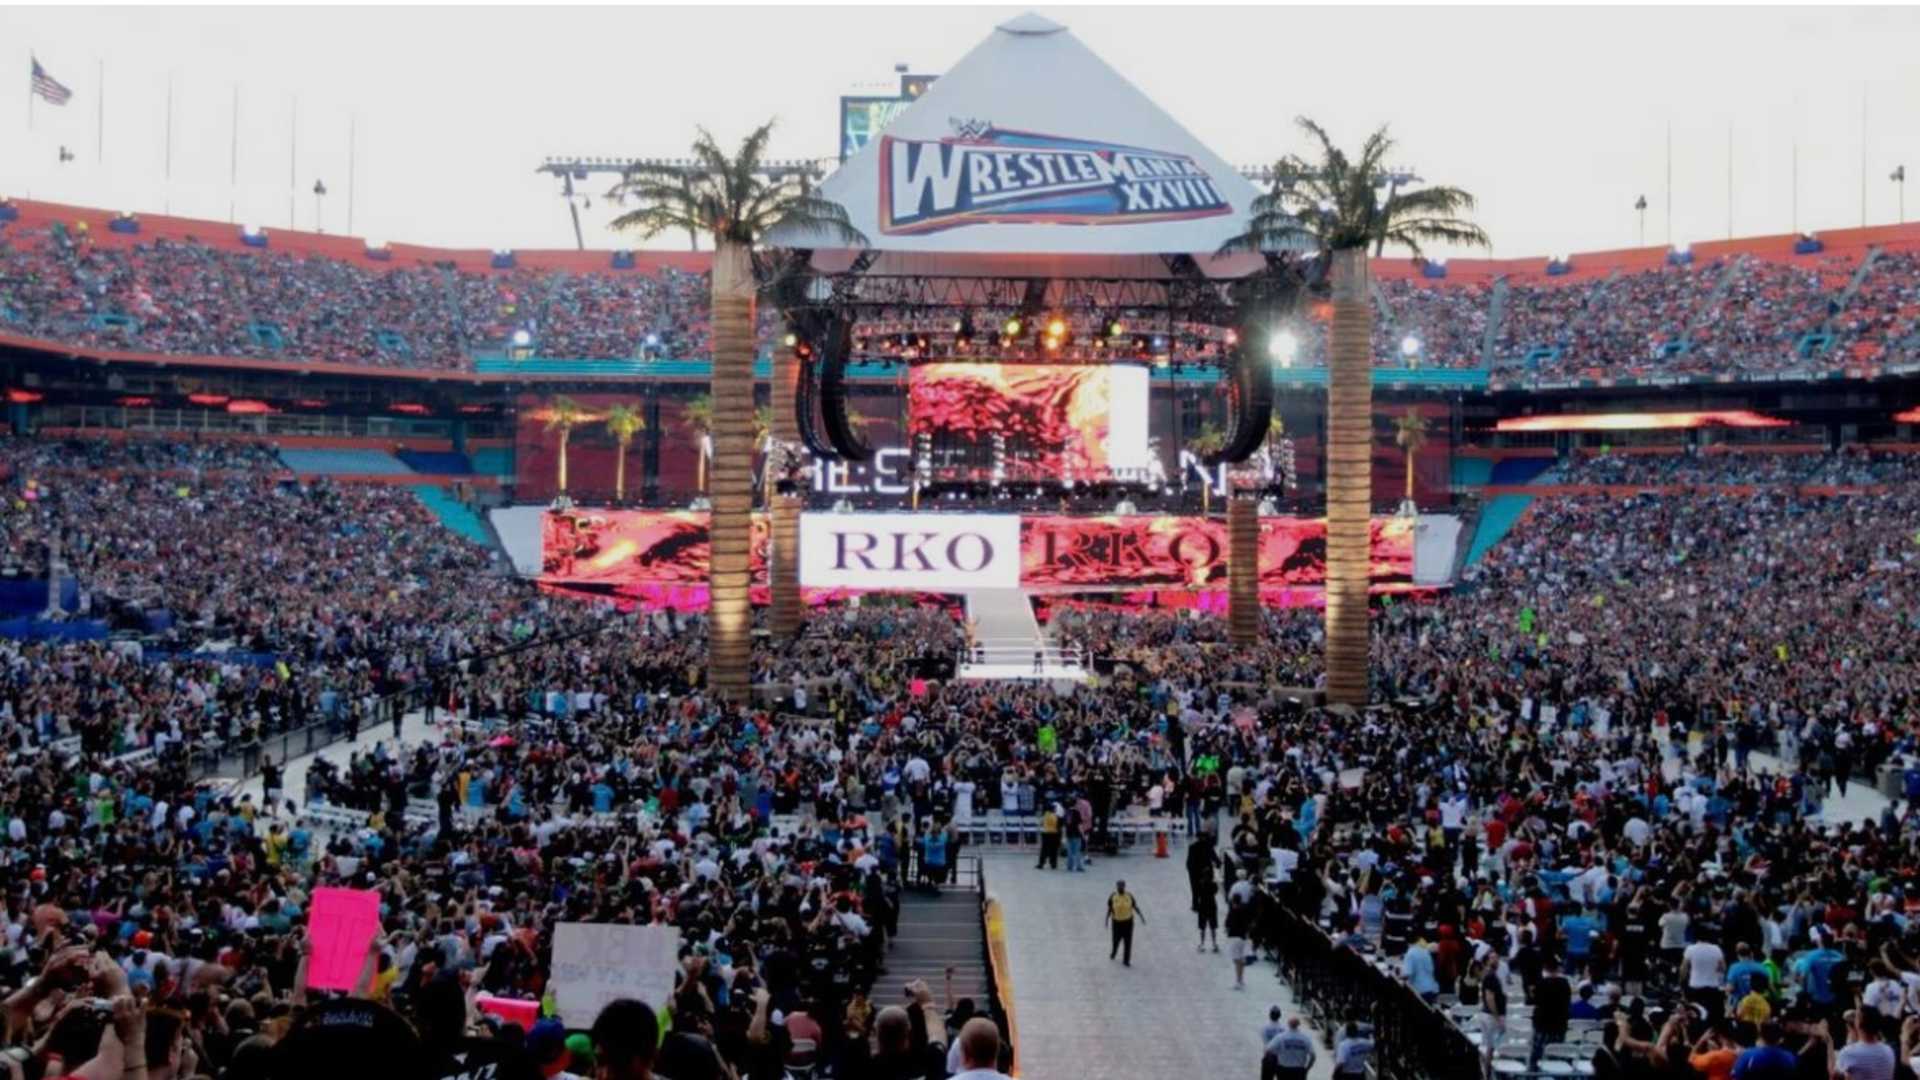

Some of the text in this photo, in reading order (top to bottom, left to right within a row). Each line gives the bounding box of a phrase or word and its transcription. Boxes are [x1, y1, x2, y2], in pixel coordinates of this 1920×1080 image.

[892, 140, 1205, 219] WRESTLEMANIA
[1120, 178, 1216, 211] XXVII
[829, 531, 994, 572] RKO
[1044, 530, 1221, 569] RKO
